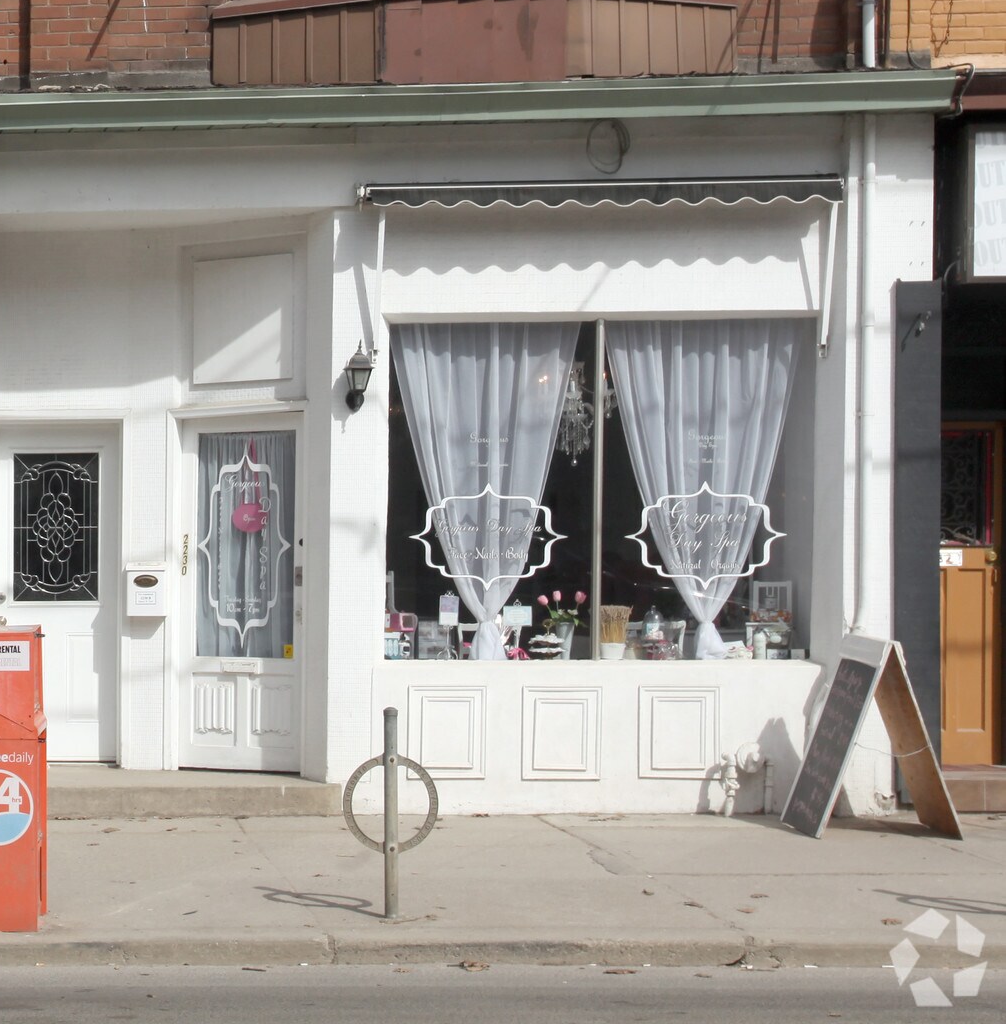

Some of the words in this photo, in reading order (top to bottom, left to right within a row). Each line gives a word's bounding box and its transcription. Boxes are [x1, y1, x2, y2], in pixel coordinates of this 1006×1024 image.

[663, 499, 747, 532] Gorgeous
[181, 534, 189, 576] 2230
[710, 531, 740, 553] Spa
